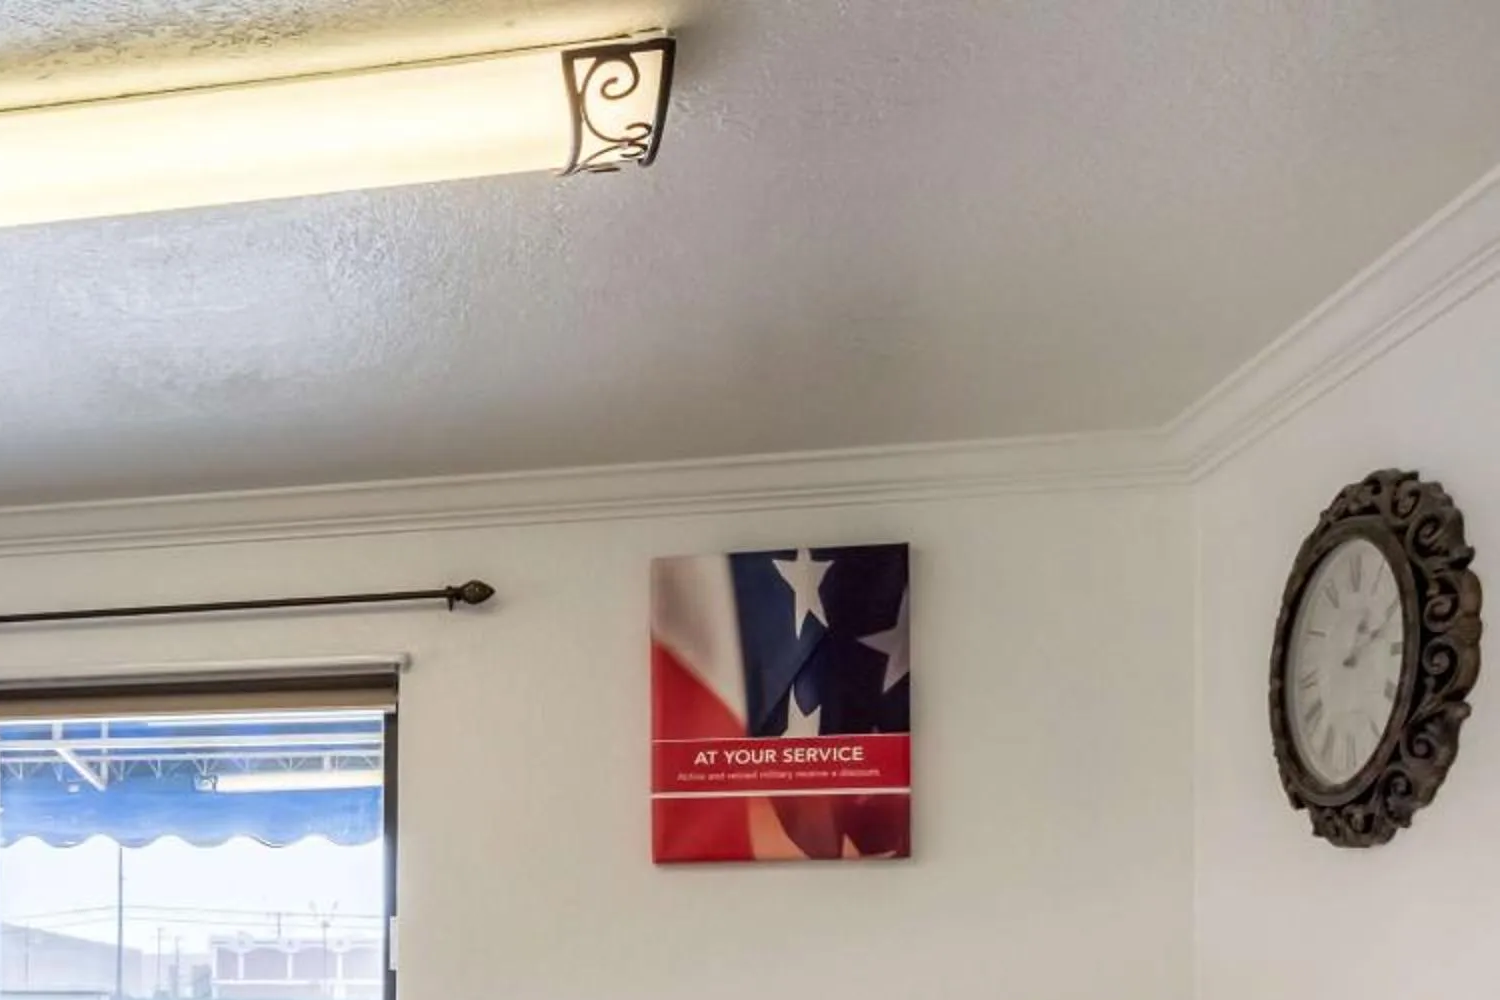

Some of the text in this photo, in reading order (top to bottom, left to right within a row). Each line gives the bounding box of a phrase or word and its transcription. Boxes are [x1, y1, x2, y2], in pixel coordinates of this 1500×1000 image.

[694, 746, 865, 765] AT YOUR SERVICE
